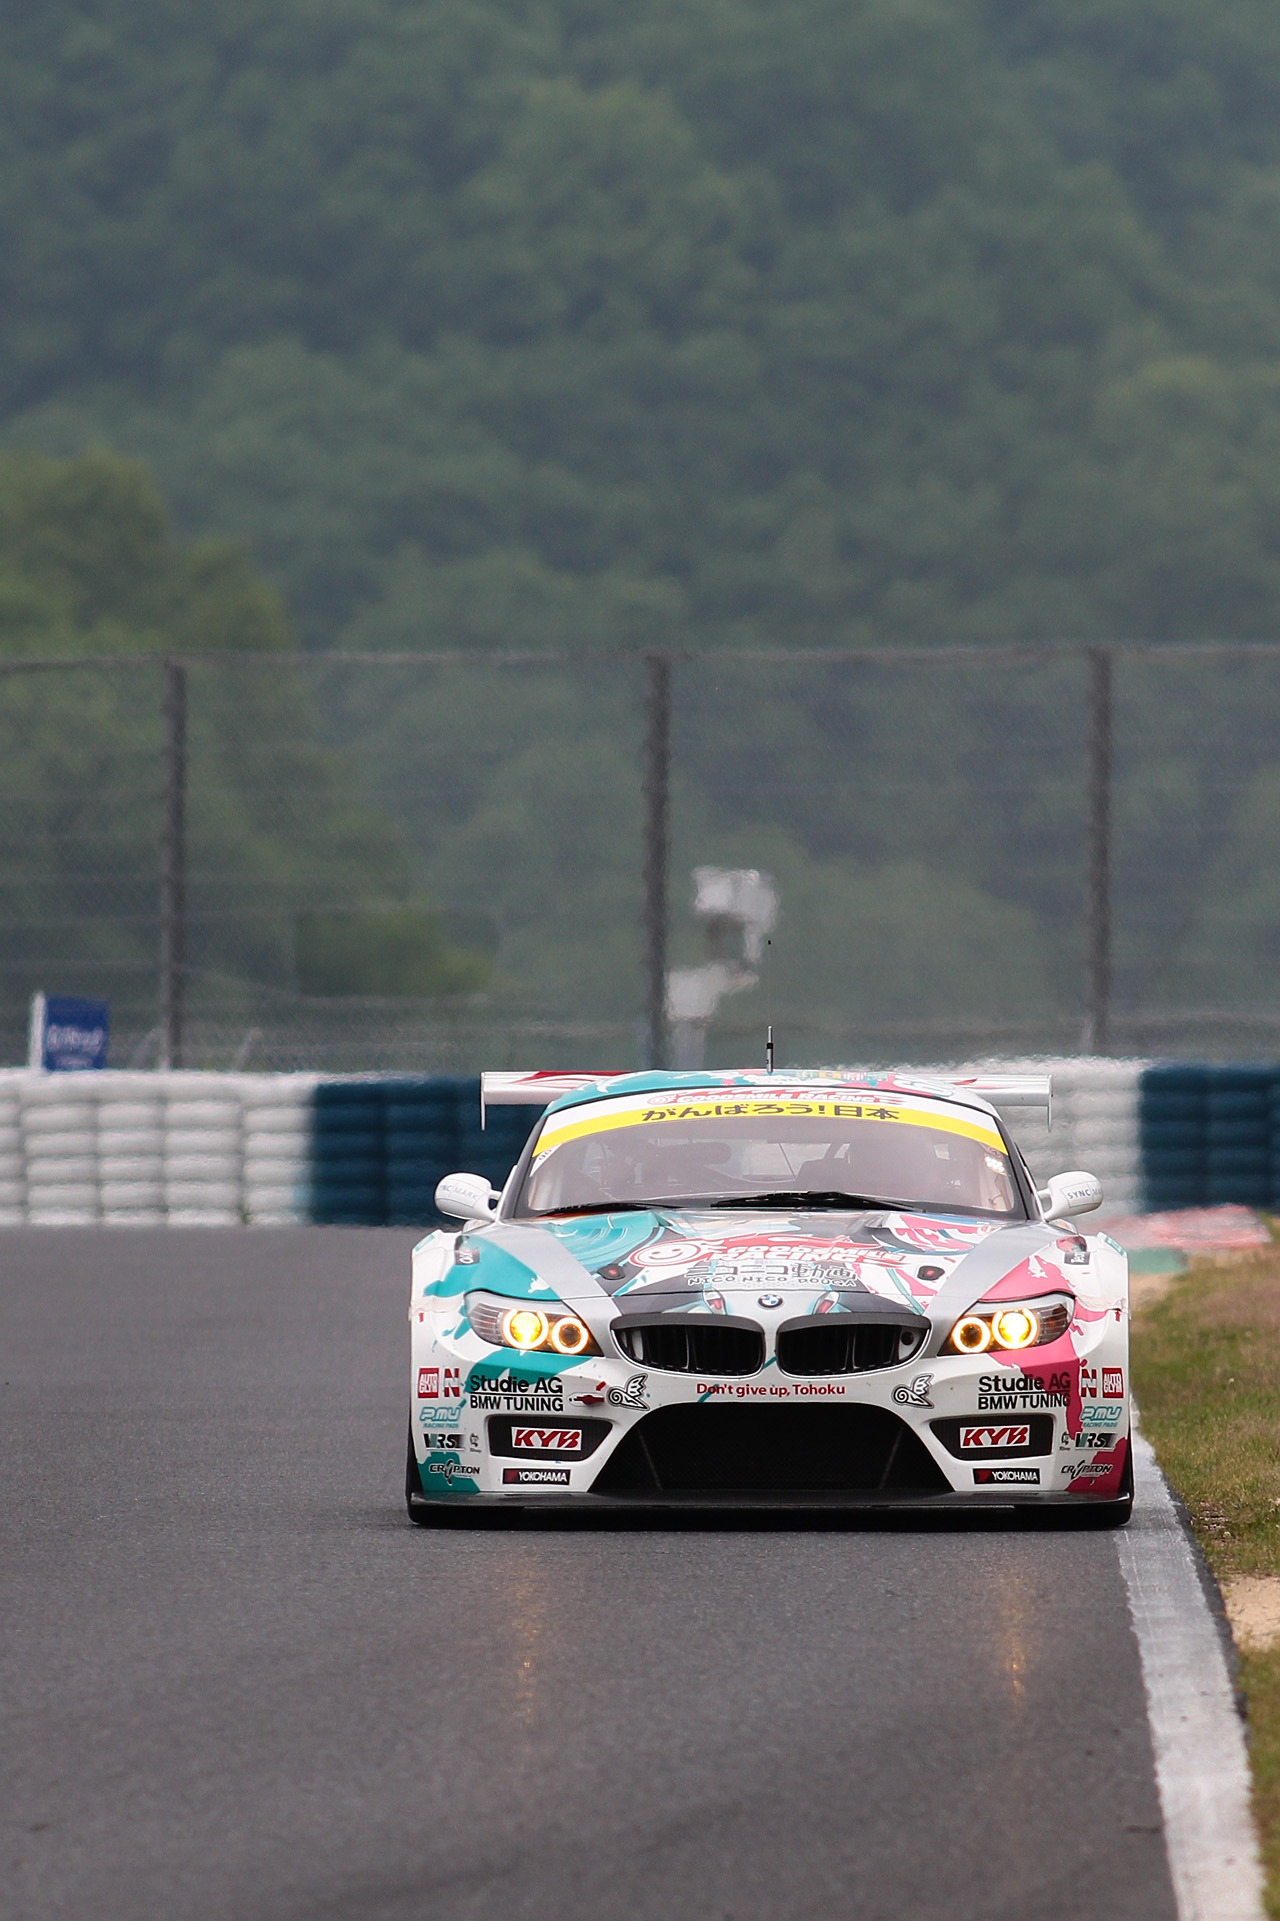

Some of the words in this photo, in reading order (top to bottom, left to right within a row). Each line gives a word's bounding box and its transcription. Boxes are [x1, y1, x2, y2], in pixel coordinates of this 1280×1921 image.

[798, 1093, 877, 1104] RACING
[641, 1104, 900, 1120] がんばろう!日本
[1067, 1189, 1091, 1200] SYNC
[687, 1276, 736, 1286] NICO
[742, 1275, 788, 1284] NICO
[798, 1277, 858, 1287] DOUGA
[470, 1374, 529, 1394] Studie
[534, 1377, 563, 1394] AG
[978, 1374, 1044, 1392] Studie
[1049, 1371, 1071, 1390] AG
[696, 1383, 734, 1396] Don't
[736, 1384, 767, 1398] give
[769, 1386, 790, 1398] up,
[792, 1383, 846, 1396] Tohoku
[470, 1395, 501, 1410] BMW
[503, 1397, 563, 1412] TUNING
[978, 1395, 1018, 1410] BMW
[1020, 1393, 1071, 1409] TUNING
[513, 1429, 581, 1449] KYB
[962, 1426, 1029, 1447] KYB
[518, 1471, 568, 1483] YOKOHAMA
[991, 1471, 1038, 1481] YOKOHAMA
[1060, 1460, 1113, 1480] CRYPTON
